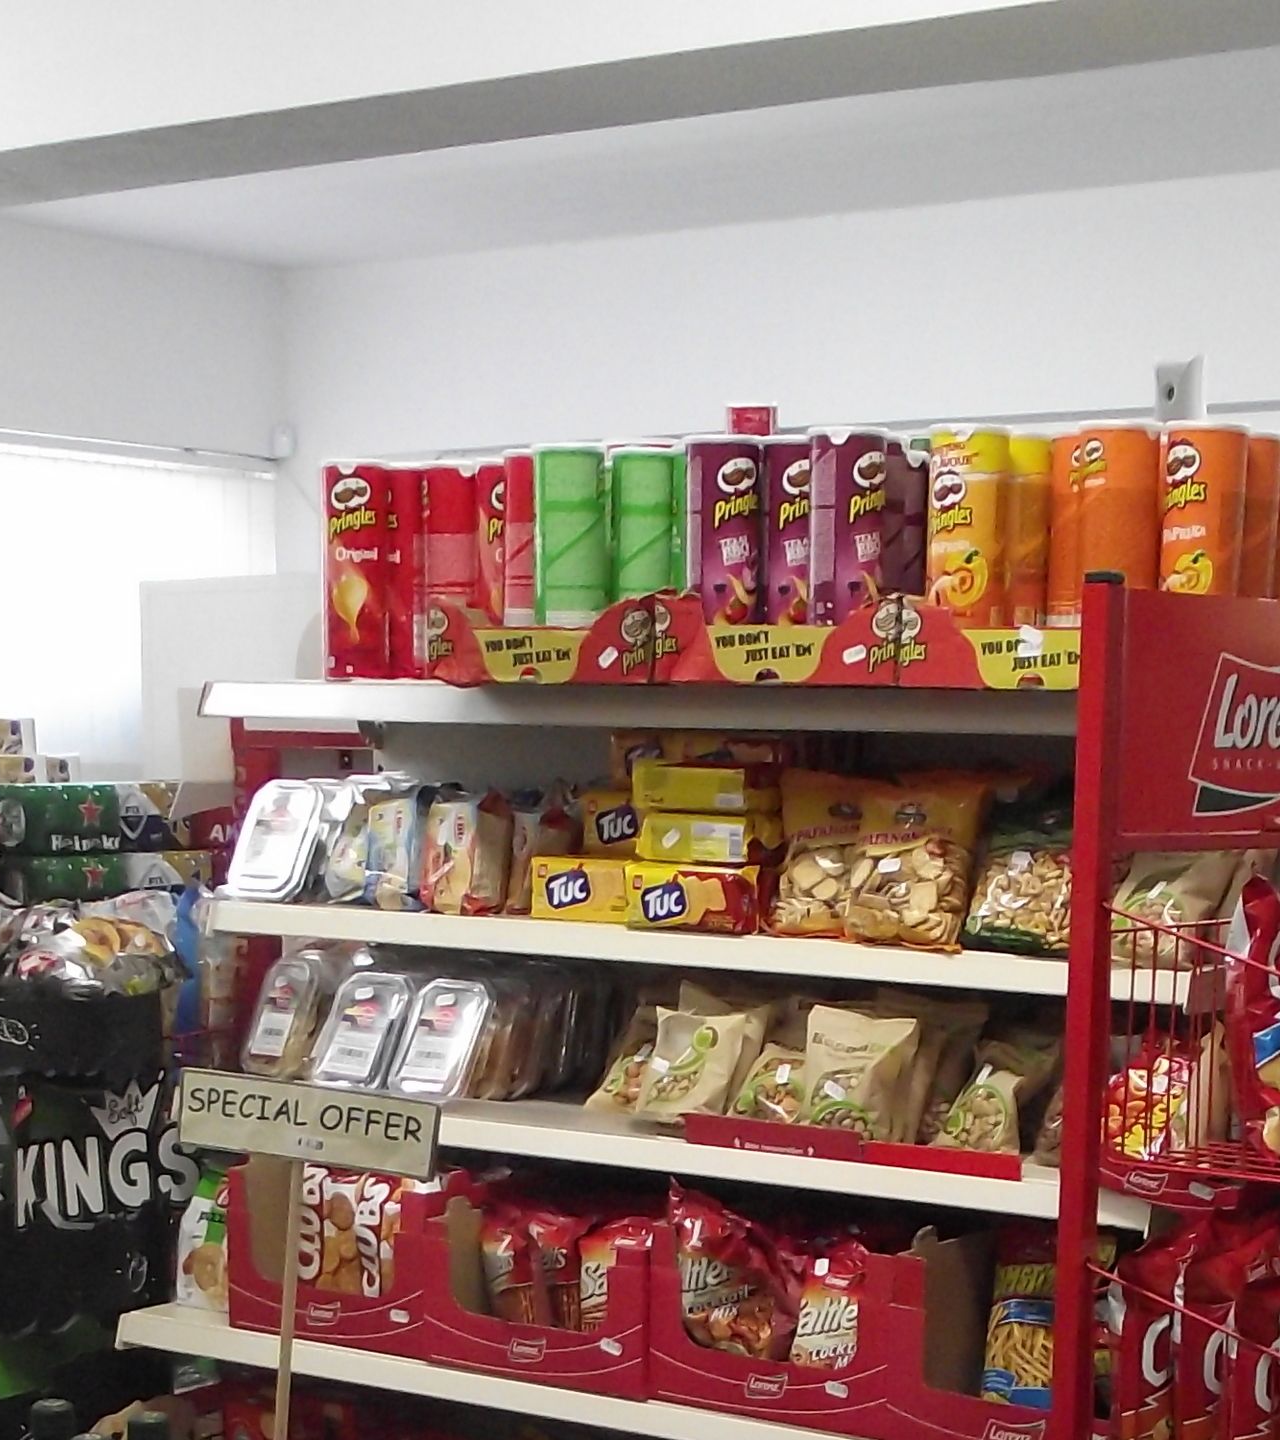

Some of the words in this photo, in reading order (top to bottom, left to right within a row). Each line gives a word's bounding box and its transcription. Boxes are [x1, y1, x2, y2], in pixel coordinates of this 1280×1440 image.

[329, 507, 376, 537] Pringles
[484, 636, 504, 653] YOU
[715, 633, 736, 650] YOU
[738, 630, 770, 647] DON'T
[981, 640, 1003, 656] YOU
[512, 650, 533, 667] JUST
[535, 649, 555, 665] EAT
[744, 648, 770, 664] JUST
[772, 646, 790, 661] EAT
[1012, 655, 1039, 672] JUST
[1040, 652, 1062, 668] EAT
[598, 810, 635, 841] TUC
[549, 876, 588, 906] TUC
[644, 887, 683, 918] TUC
[188, 1086, 308, 1126] SPECIAL
[319, 1104, 424, 1143] OFFER
[15, 1120, 201, 1229] KINGS
